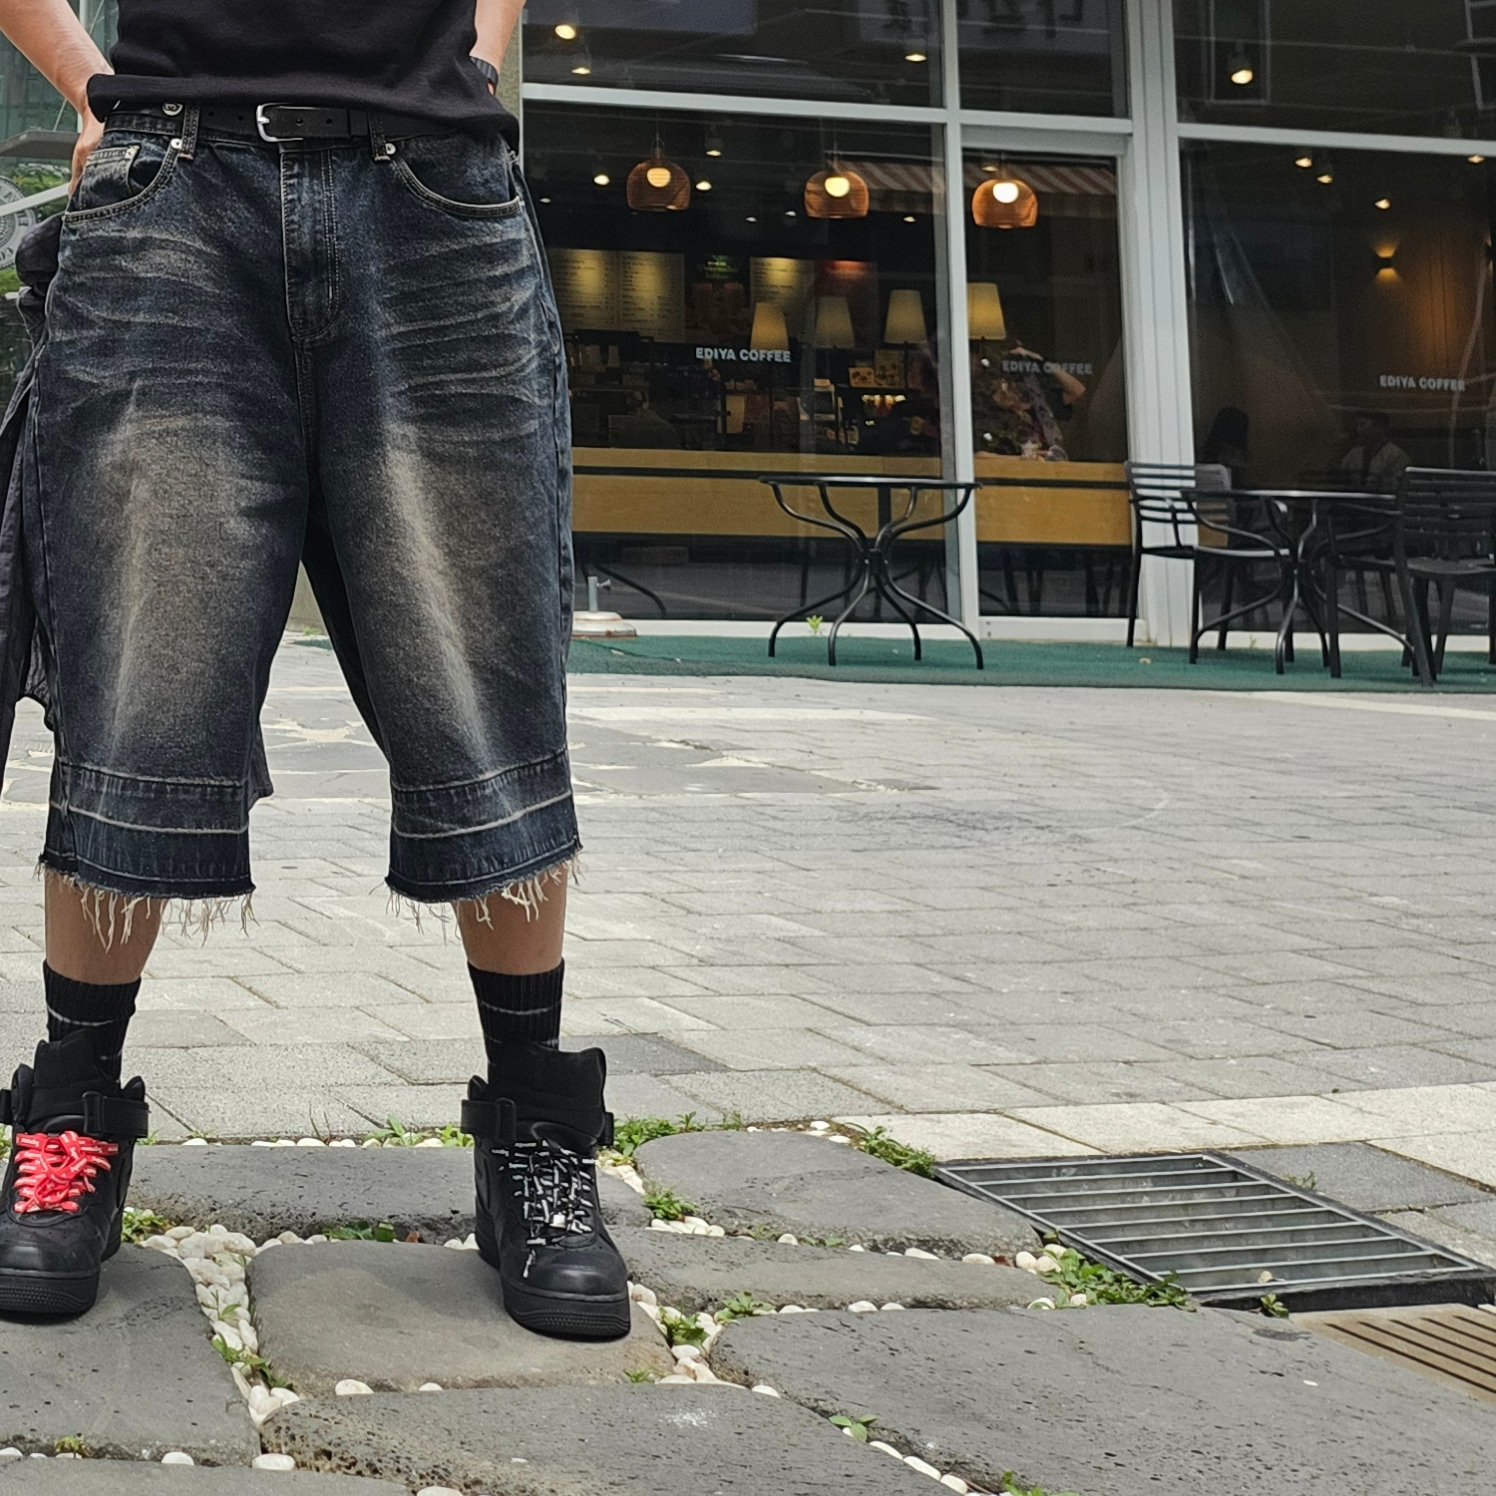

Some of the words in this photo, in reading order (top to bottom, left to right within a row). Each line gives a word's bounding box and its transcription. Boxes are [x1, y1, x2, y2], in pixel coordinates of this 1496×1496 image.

[695, 347, 736, 361] EDIYA
[739, 349, 792, 363] COFFEE
[1002, 360, 1040, 373] EDIYA
[1379, 375, 1416, 389] EDIYA
[1419, 376, 1465, 392] COFFEE
